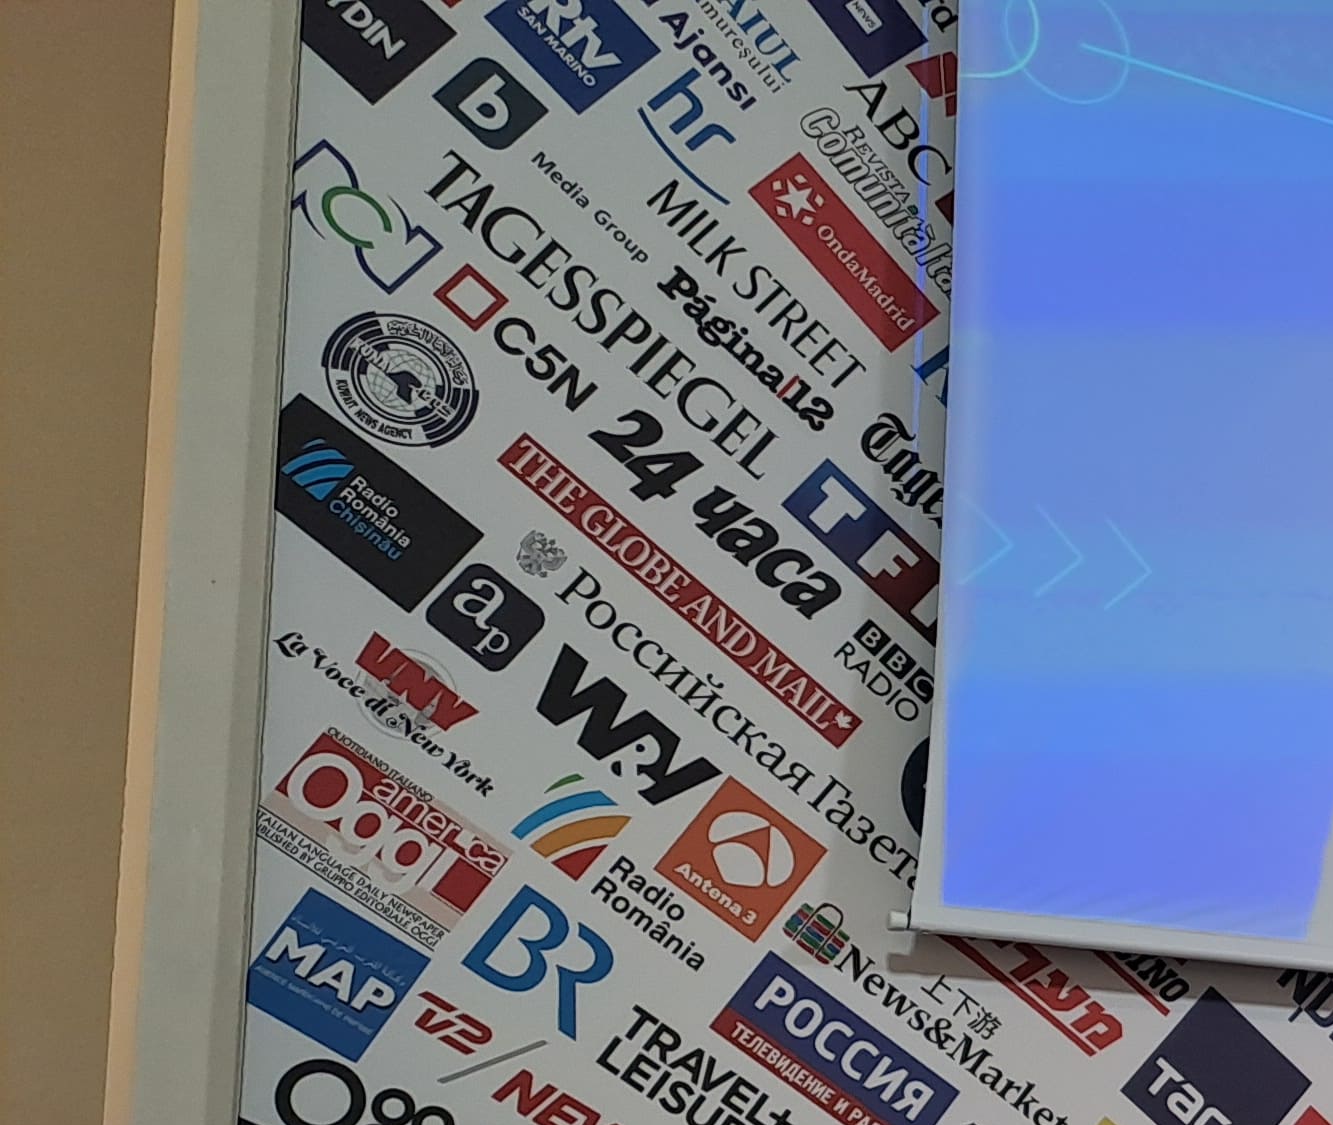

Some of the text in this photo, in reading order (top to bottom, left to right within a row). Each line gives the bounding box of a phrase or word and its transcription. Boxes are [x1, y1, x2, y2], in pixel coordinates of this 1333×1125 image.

[516, 6, 597, 88] SAN MARINO
[457, 72, 510, 130] b
[646, 67, 737, 152] hr
[843, 79, 953, 187] ABC
[530, 151, 649, 267] Media Group
[424, 149, 780, 481] TAGESSPIEGEL
[646, 178, 868, 389] MILK STREET
[815, 224, 917, 333] OndaMadrid
[335, 378, 413, 440] KUWAIT NEWS AGENCY
[494, 317, 599, 413] C5N
[349, 475, 400, 520] Radio
[588, 408, 705, 503] 24
[338, 488, 412, 550] România
[451, 576, 512, 657] ap
[508, 440, 836, 732] THE GLOBE AND MAIL
[555, 566, 816, 796] Российская
[833, 641, 921, 723] RADIO
[852, 618, 936, 705] BBC
[272, 630, 495, 799] La Voce di New York
[326, 725, 434, 803] QUOTIDIANO ITALIANO
[298, 837, 446, 941] LANGUAGE DAILY NEWSPAPER
[312, 861, 440, 948] GRUPPO EDITORIALE OGGI
[589, 877, 706, 973] România
[607, 854, 687, 923] Radio
[672, 861, 758, 928] Antena 3
[264, 925, 398, 1014] MAP
[460, 884, 615, 1043] BR
[754, 974, 936, 1124] РОССИЯ
[920, 974, 1003, 1042] 上下游
[729, 1020, 837, 1107] ТЕЛЕВИДЕНИЕ
